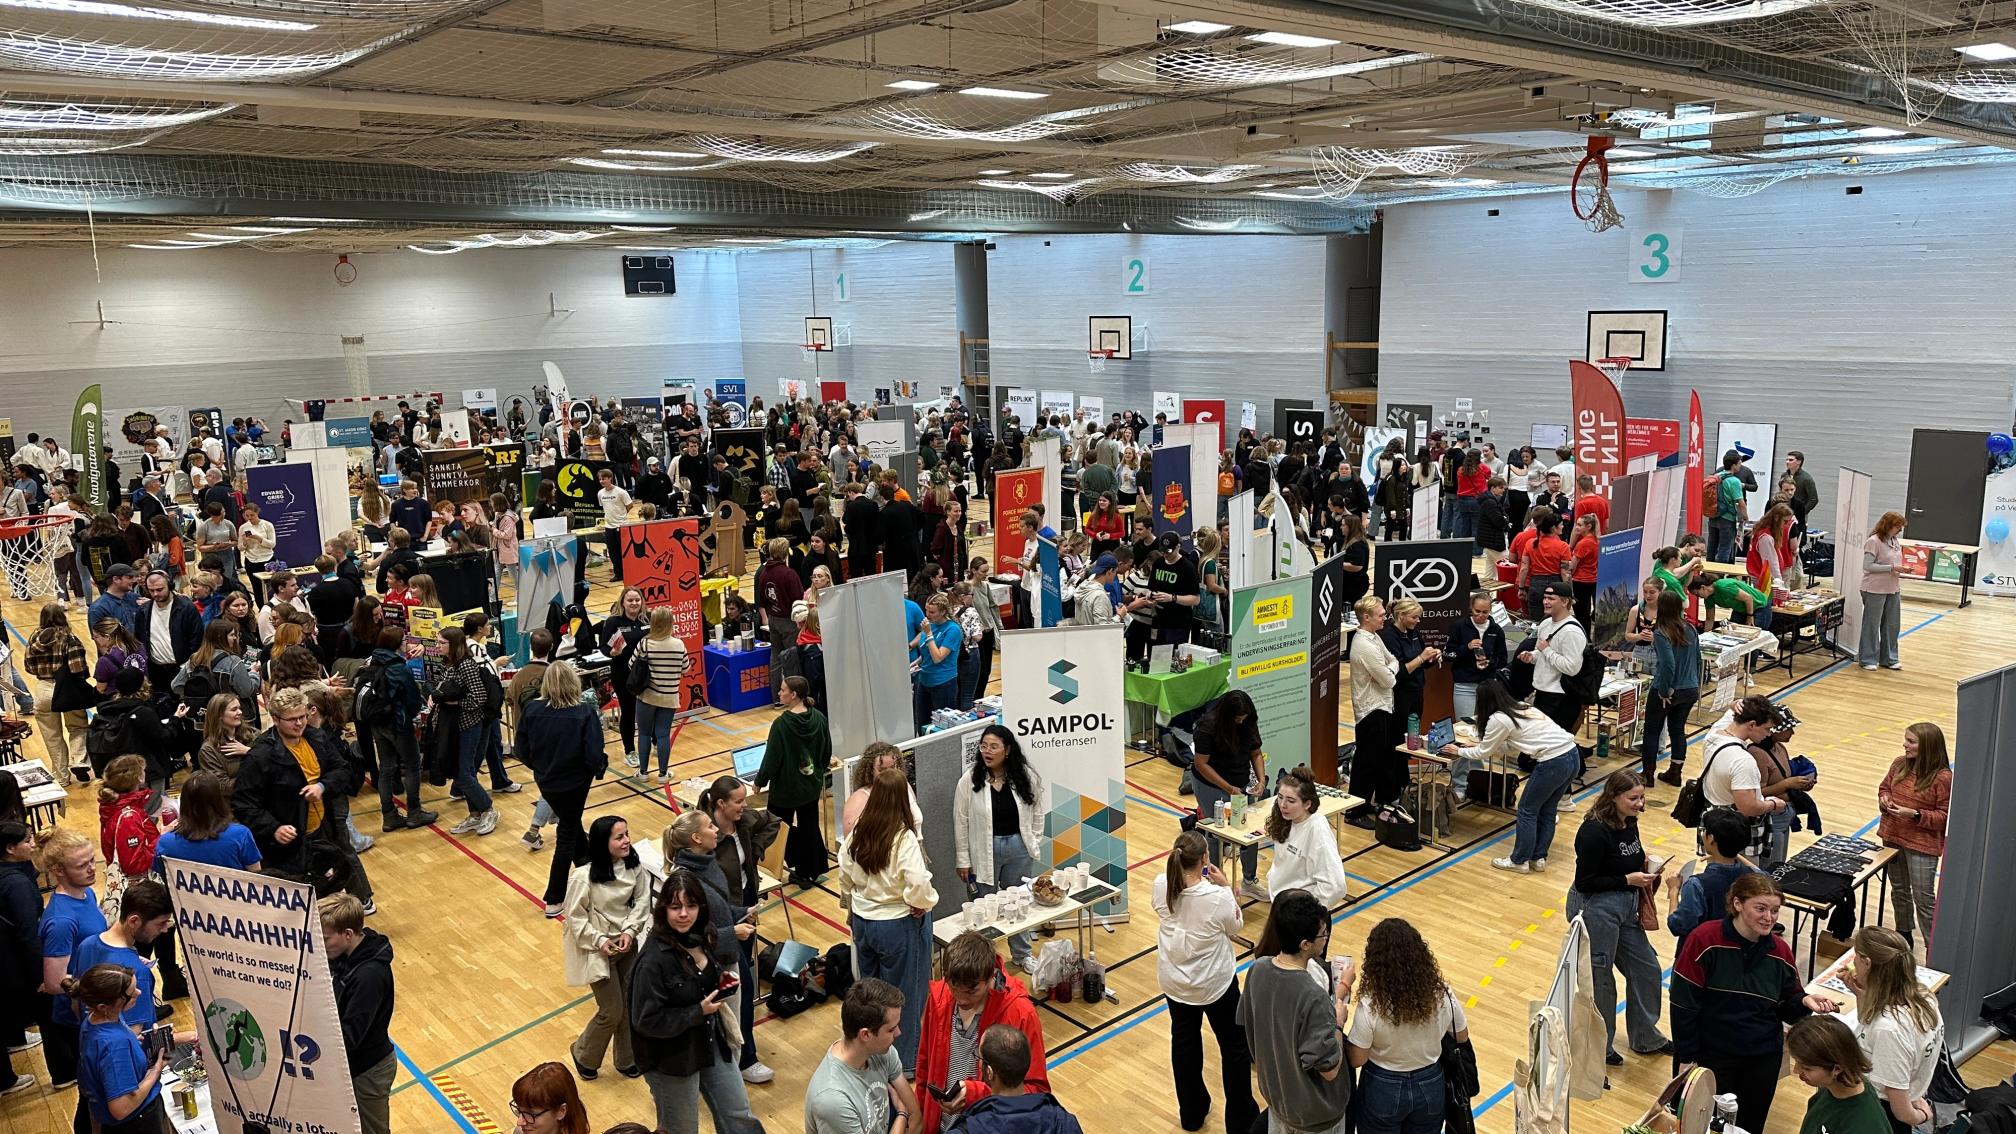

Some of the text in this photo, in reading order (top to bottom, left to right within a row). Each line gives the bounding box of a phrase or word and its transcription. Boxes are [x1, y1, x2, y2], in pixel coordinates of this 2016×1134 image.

[1640, 233, 1670, 278] 3
[1128, 259, 1144, 291] 2
[836, 272, 845, 298] 1
[87, 420, 104, 506] Navigatorene
[429, 463, 462, 472] SANKTA
[430, 471, 468, 480] SUNNIVA
[431, 478, 480, 489] KAMMERKOR
[1155, 568, 1177, 584] NITO
[1257, 603, 1278, 614] AMNESTY
[1031, 736, 1097, 749] konferansen
[188, 943, 206, 956] The
[207, 946, 234, 962] world
[236, 952, 243, 964] is
[246, 956, 257, 967] so
[259, 959, 295, 975] messed
[212, 966, 292, 990] what can we do!?
[296, 1123, 303, 1132] a
